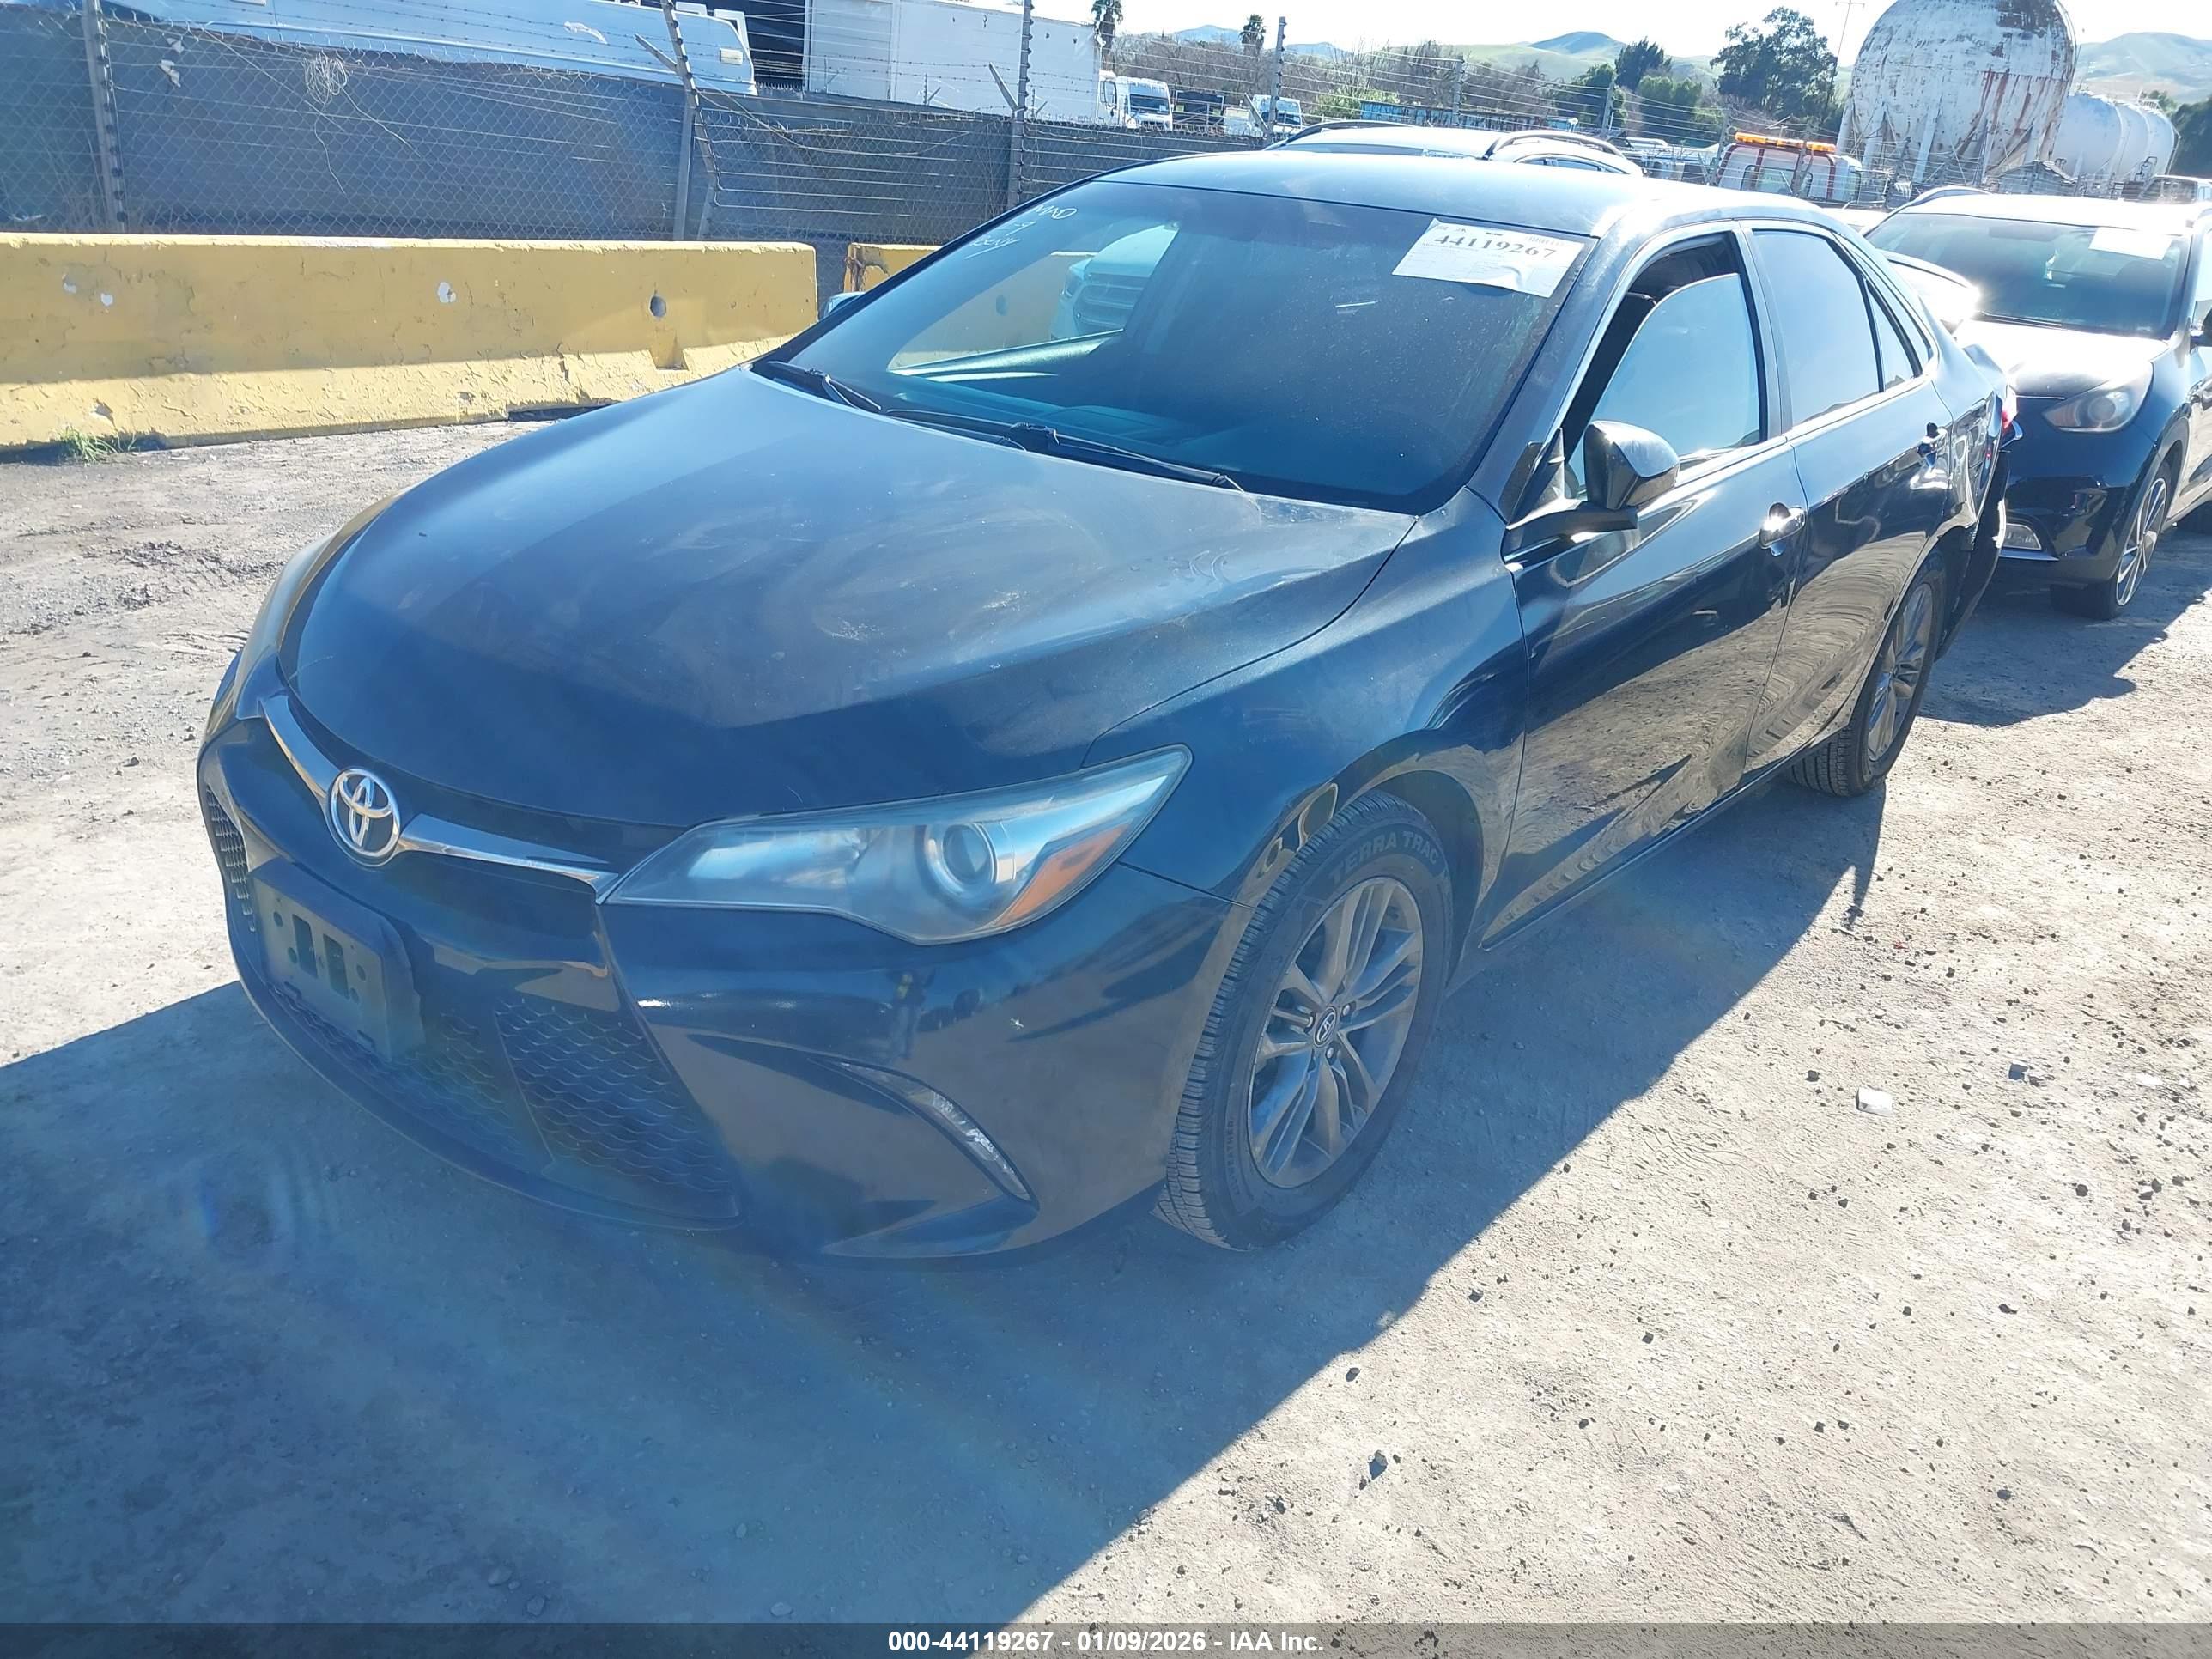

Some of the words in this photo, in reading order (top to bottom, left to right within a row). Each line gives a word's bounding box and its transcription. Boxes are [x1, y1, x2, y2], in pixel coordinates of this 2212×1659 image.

[1433, 234, 1558, 258] 44119267
[1328, 831, 1398, 886] TERRA
[1401, 830, 1440, 865] TRAC
